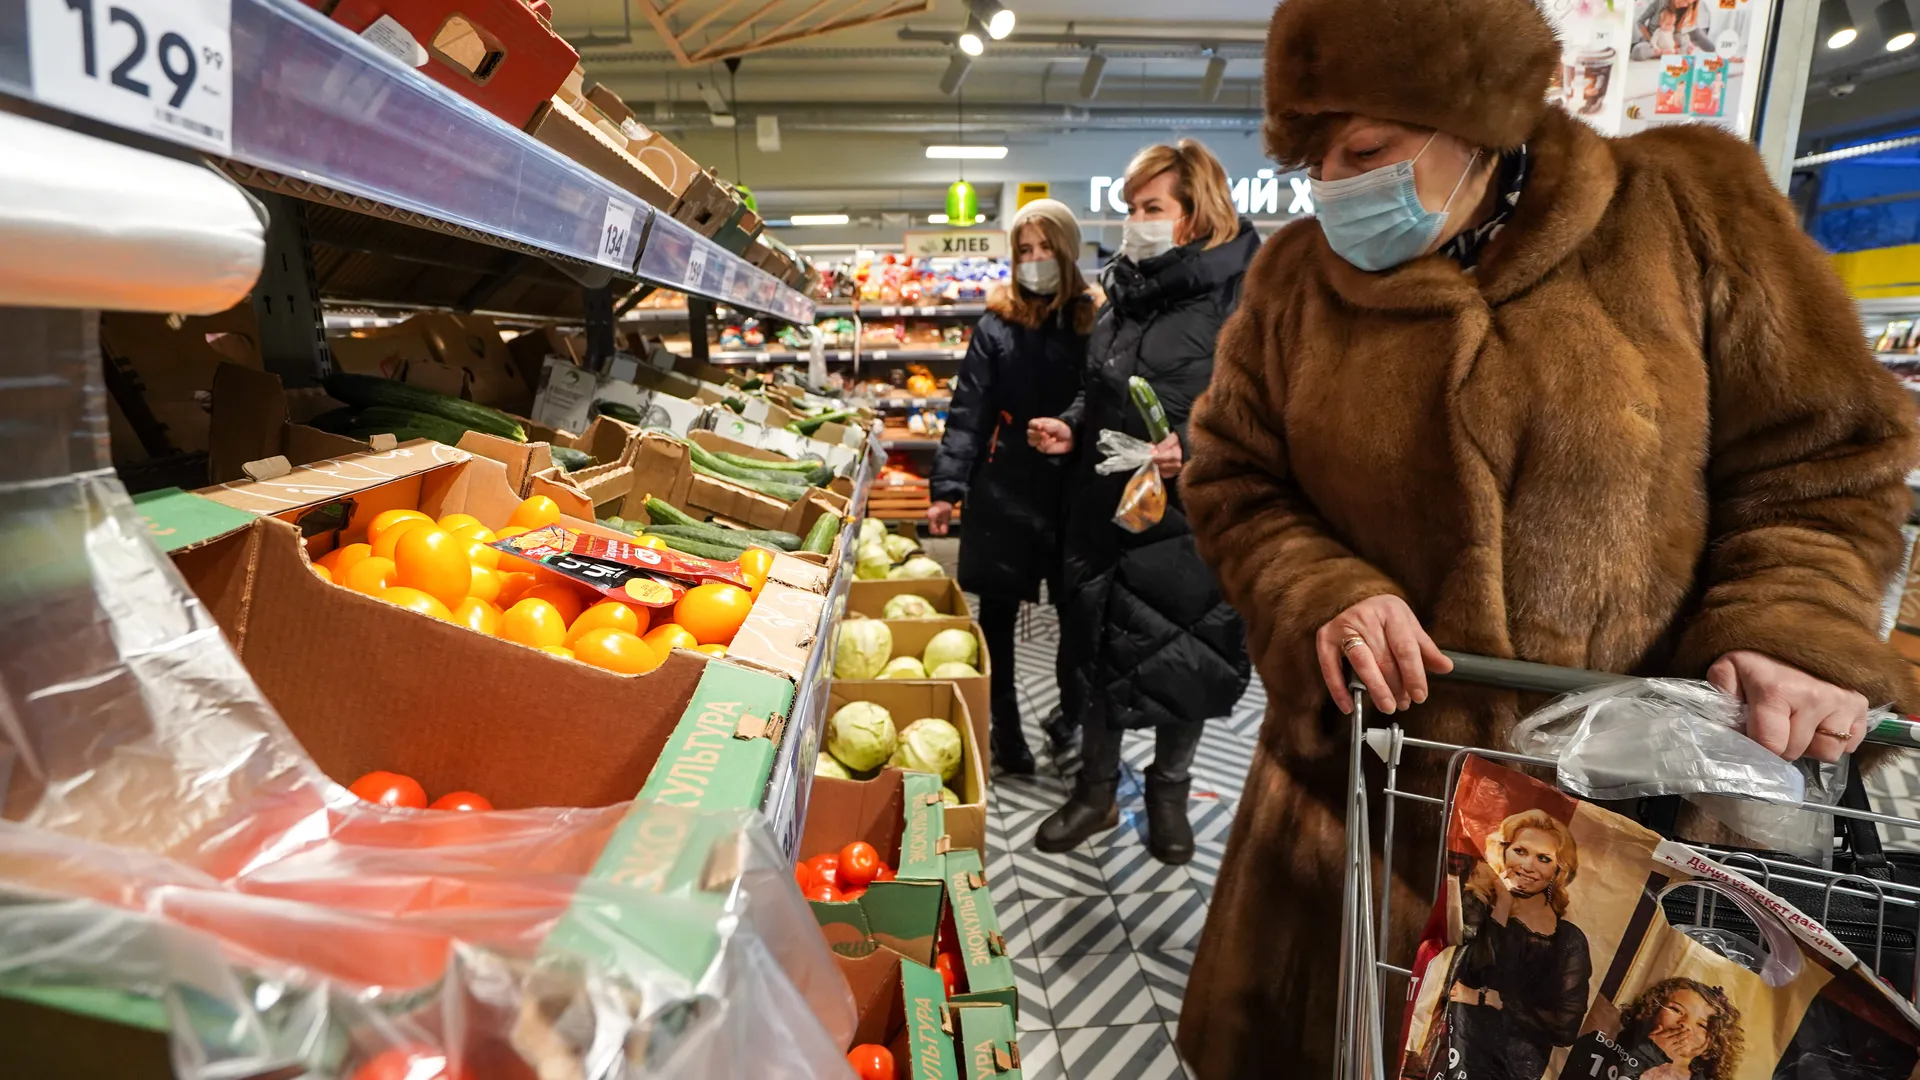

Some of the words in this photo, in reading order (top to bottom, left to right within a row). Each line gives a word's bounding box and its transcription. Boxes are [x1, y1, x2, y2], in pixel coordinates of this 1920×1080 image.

[64, 0, 197, 109] 129
[604, 223, 625, 257] 134
[943, 237, 989, 253] ХЛЕБ
[909, 791, 928, 864] ЭКОКУЛЬТУРА
[953, 870, 991, 967] ЭКОКУЛЬТУРА
[1595, 1030, 1639, 1068] Болеро
